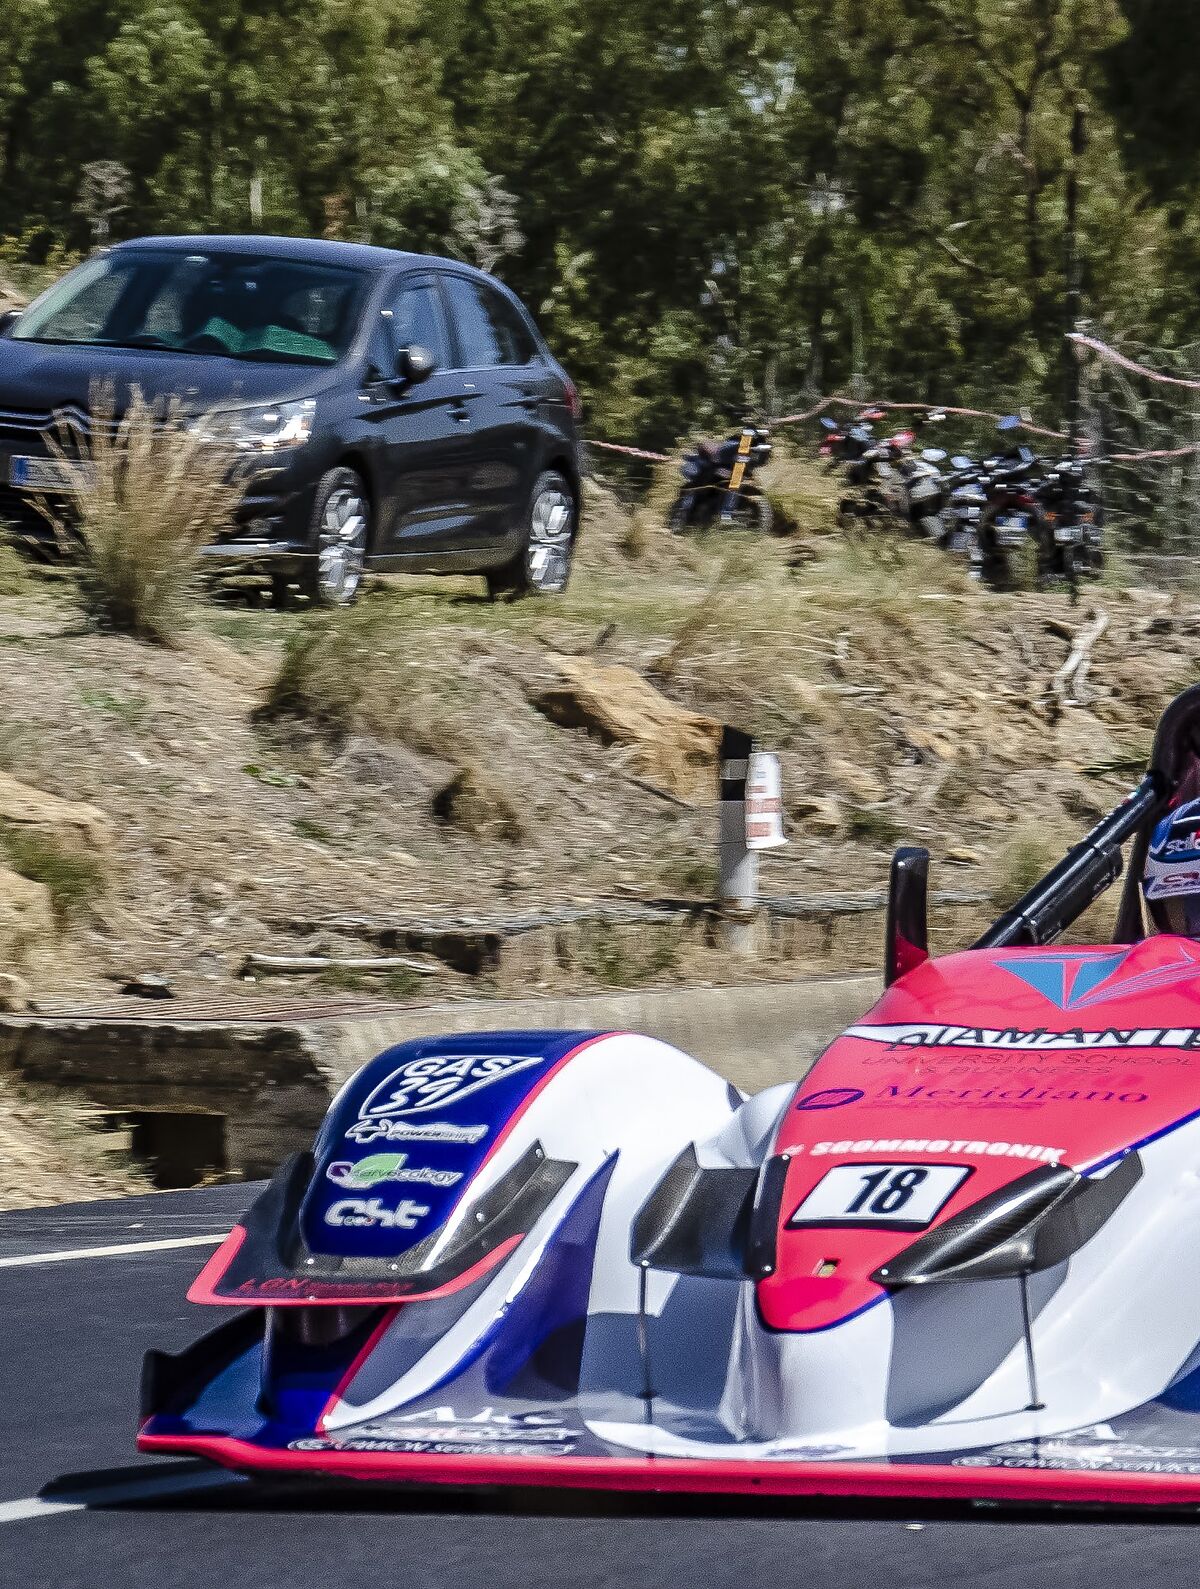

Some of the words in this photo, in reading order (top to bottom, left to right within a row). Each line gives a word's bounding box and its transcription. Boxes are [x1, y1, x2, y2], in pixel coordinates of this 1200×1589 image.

[403, 1057, 511, 1078] GAS
[1061, 1053, 1194, 1067] SCHOOL
[876, 1084, 1150, 1103] Meridiano
[844, 1166, 930, 1215] 18
